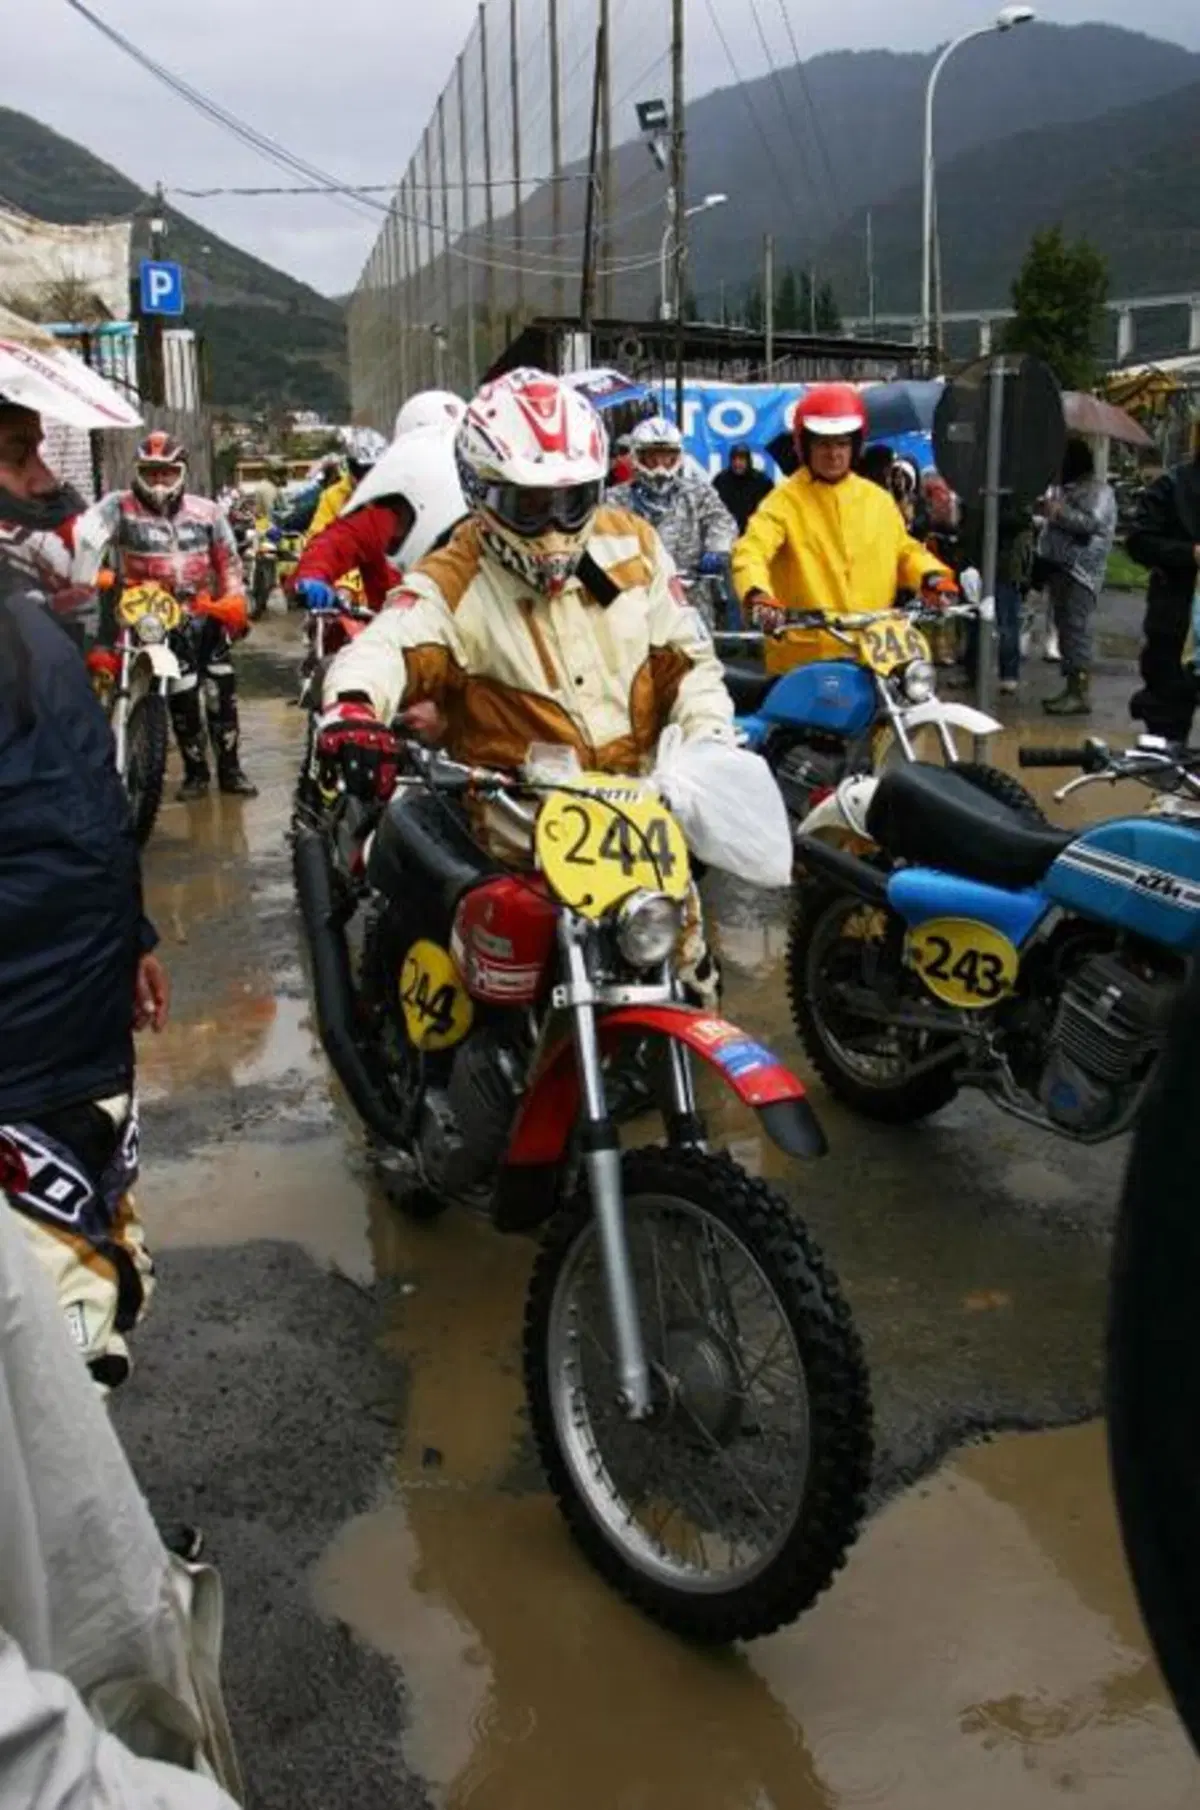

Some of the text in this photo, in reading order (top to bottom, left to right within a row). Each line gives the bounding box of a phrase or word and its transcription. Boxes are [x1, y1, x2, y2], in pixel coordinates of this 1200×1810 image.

[150, 269, 173, 306] P
[866, 625, 926, 662] 246
[561, 804, 676, 877] 244
[925, 935, 1004, 998] 243
